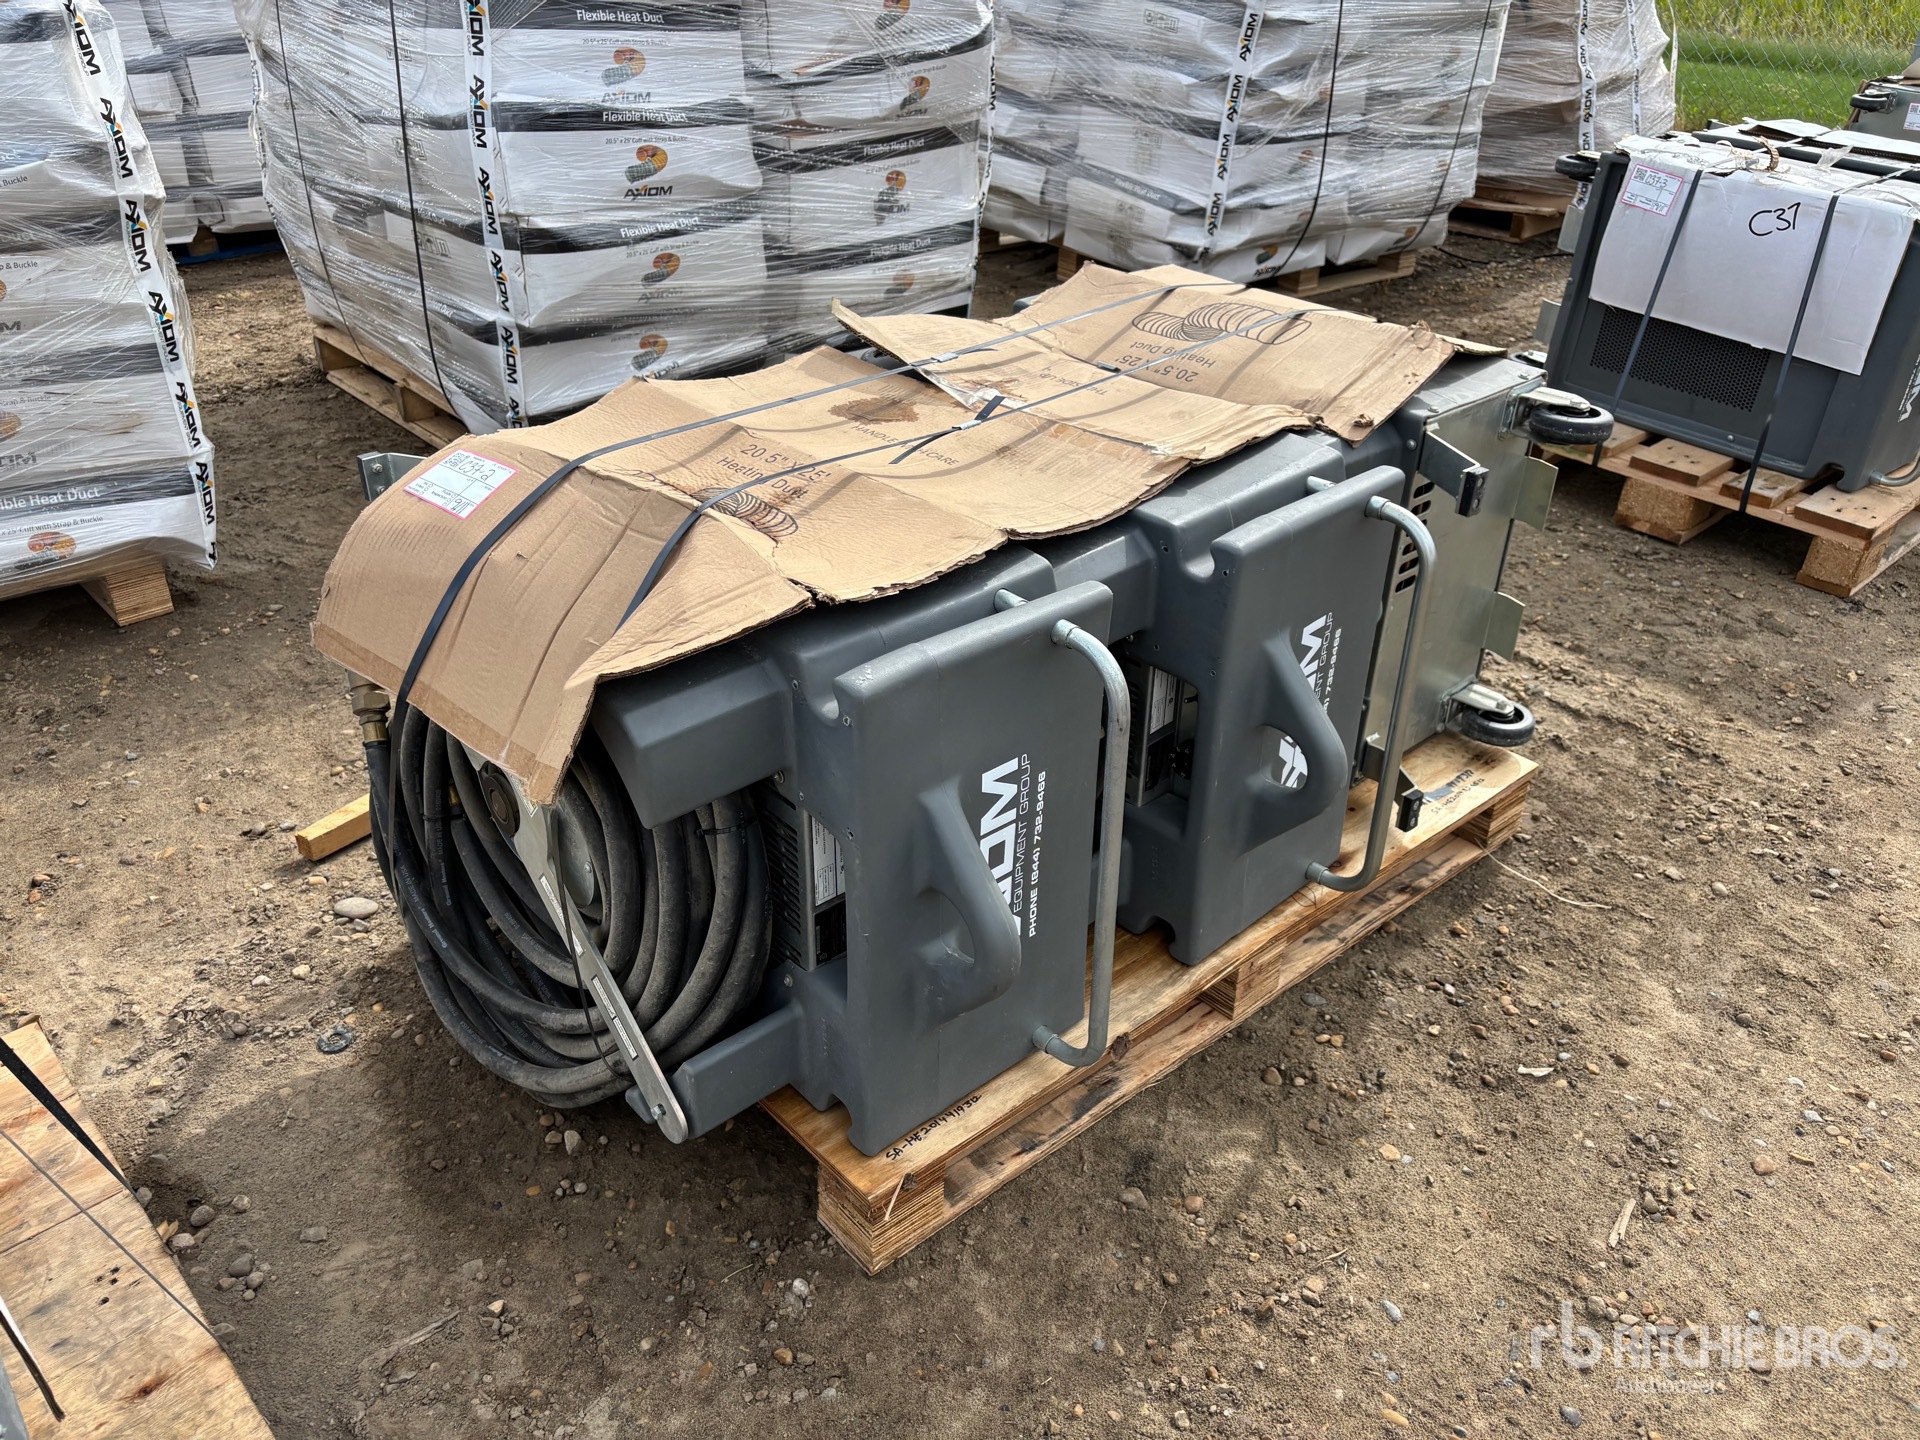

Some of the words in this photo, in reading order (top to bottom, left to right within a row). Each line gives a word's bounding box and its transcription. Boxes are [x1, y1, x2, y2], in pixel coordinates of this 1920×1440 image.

[62, 0, 101, 75] XIOM
[576, 9, 616, 21] Flexible
[617, 10, 641, 22] Heat
[642, 12, 665, 23] Duct
[1239, 13, 1258, 62] AXIOM
[469, 74, 488, 148] AXIOM
[601, 91, 651, 105] AXIOM
[602, 111, 641, 122] Flexible
[642, 109, 665, 122] Heat
[1226, 75, 1243, 122] AXIOM
[1583, 89, 1593, 123] AXIOM
[100, 97, 133, 178] AXIOM
[908, 138, 925, 149] Duct
[1217, 134, 1231, 180] AXIOM
[2, 175, 28, 187] Buckle
[478, 166, 499, 235] AXIOM
[623, 185, 673, 201] AXIOM
[125, 199, 152, 272] AXIOM
[620, 225, 657, 238] Flexible
[656, 220, 679, 232] Heat
[1208, 193, 1222, 237] AXIOM
[13, 260, 39, 269] Buckle
[490, 250, 510, 313] AXIOM
[148, 290, 180, 363] AXIOM
[1130, 341, 1162, 354] Duct
[500, 325, 519, 385] AXIOM
[1115, 354, 1142, 367] 25'
[1154, 365, 1199, 383] 20.5"
[1162, 346, 1216, 369] Heatig
[175, 381, 202, 448] AXIOM
[740, 444, 789, 463] 20.5"
[797, 466, 832, 481] 25'
[851, 424, 900, 444] HANDLE
[925, 450, 959, 466] CARE
[28, 491, 63, 507] Heat
[66, 486, 102, 501] Duct
[195, 461, 216, 526] AXIOM
[717, 456, 764, 481] Heatin
[771, 478, 809, 498] Duct
[1320, 612, 1333, 666] GROUP
[1019, 753, 1031, 815] GROUP
[1013, 821, 1028, 913] EQUIPMENT
[1031, 847, 1041, 886] (844)
[1029, 887, 1039, 937] PHONE
